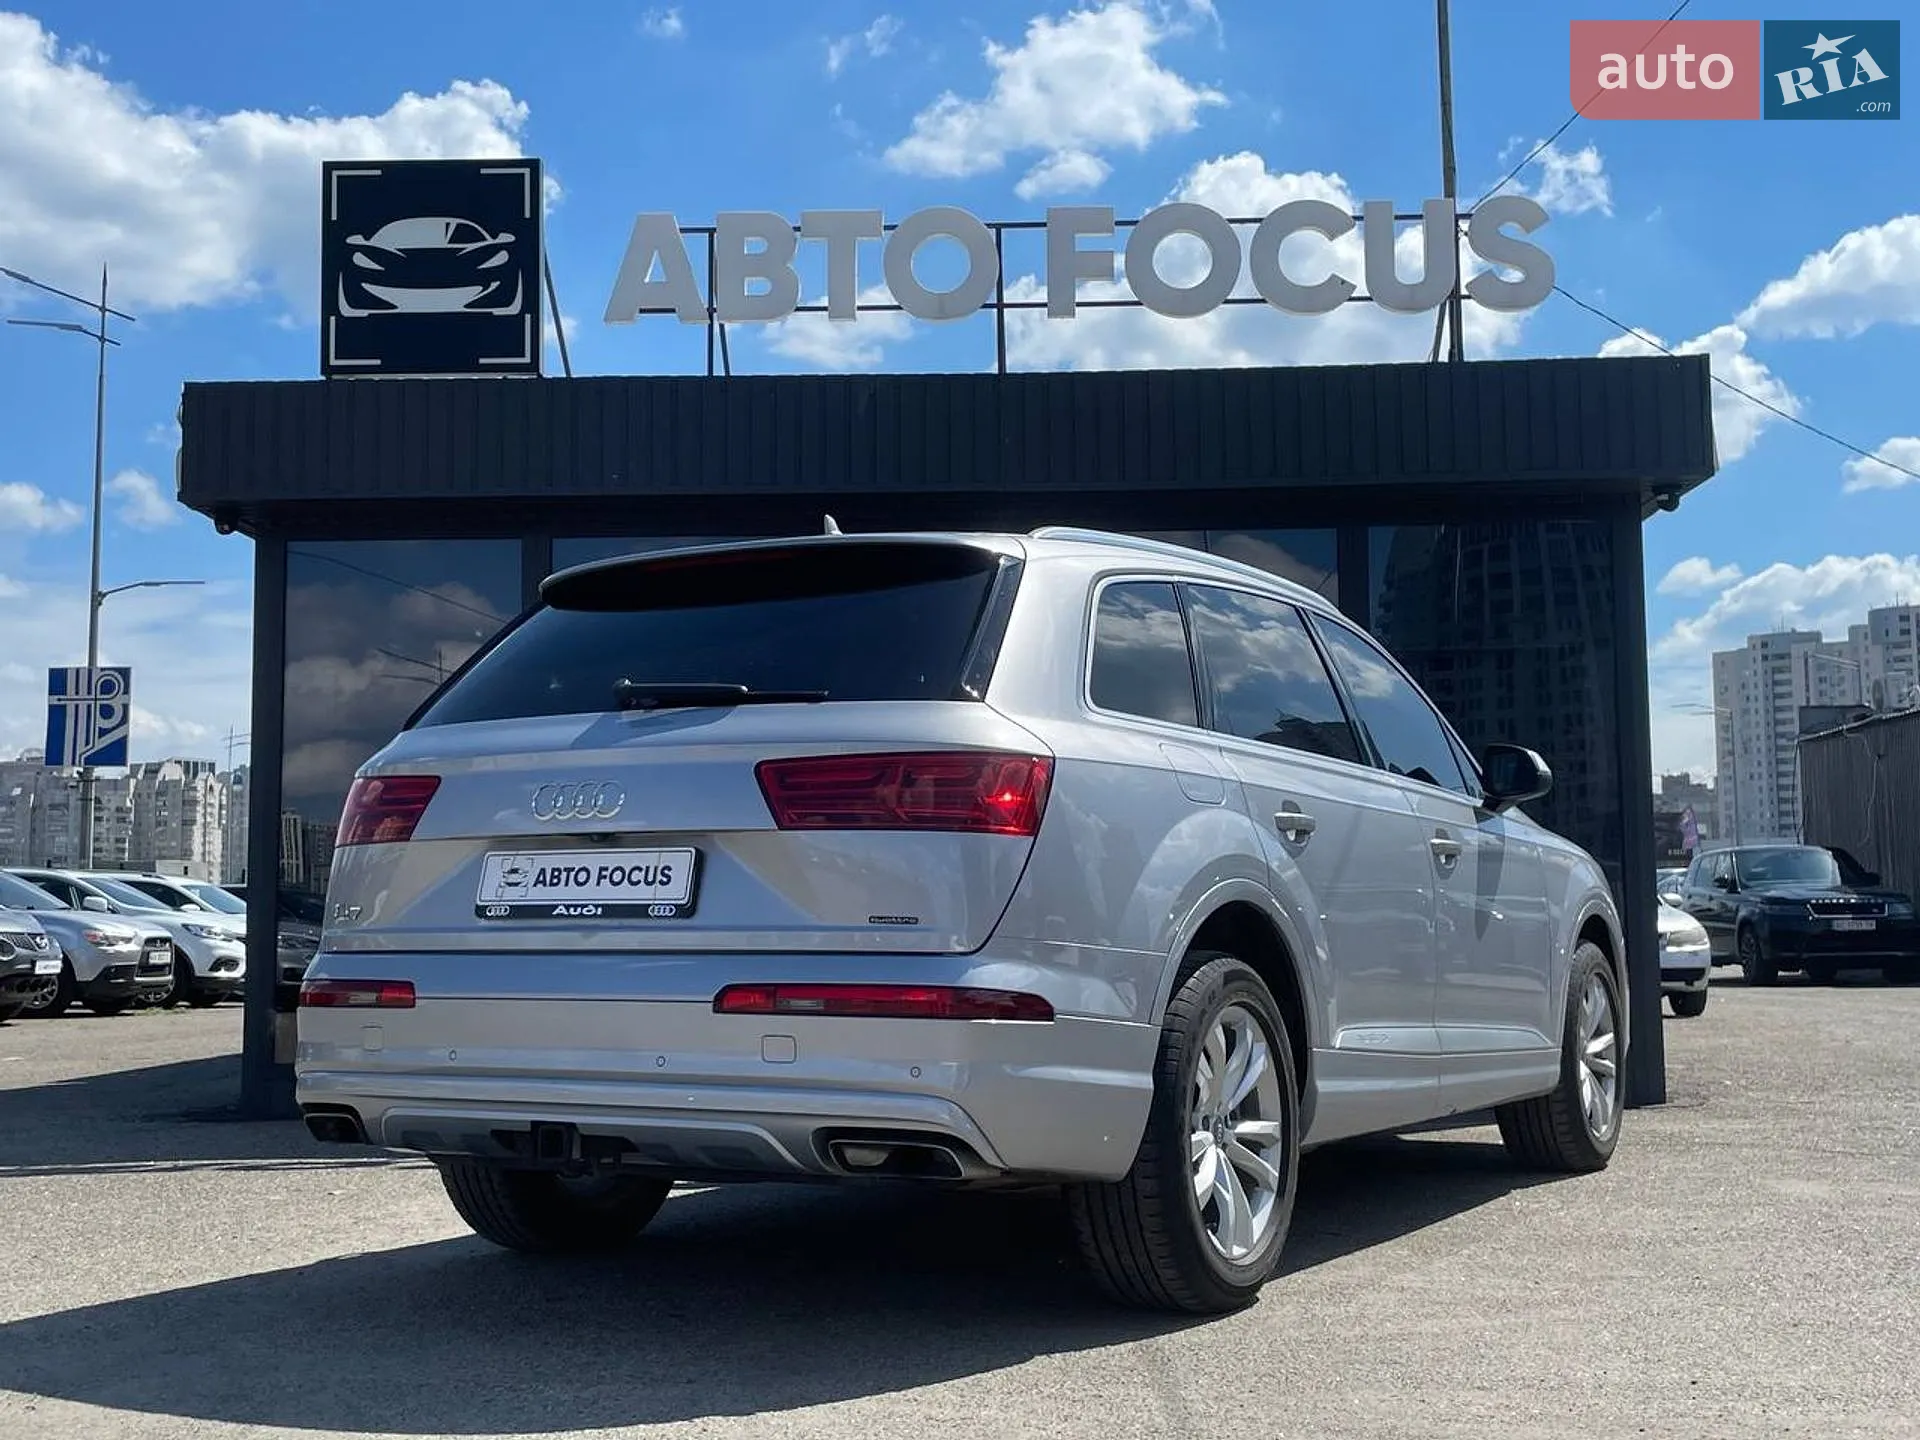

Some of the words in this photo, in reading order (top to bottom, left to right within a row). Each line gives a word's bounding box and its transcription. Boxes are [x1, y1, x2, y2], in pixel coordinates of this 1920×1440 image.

[603, 206, 999, 325] АВТО
[1046, 196, 1555, 319] FOCUS
[533, 866, 591, 888] АВТО
[596, 865, 673, 887] FOCUS
[552, 905, 602, 915] Audi
